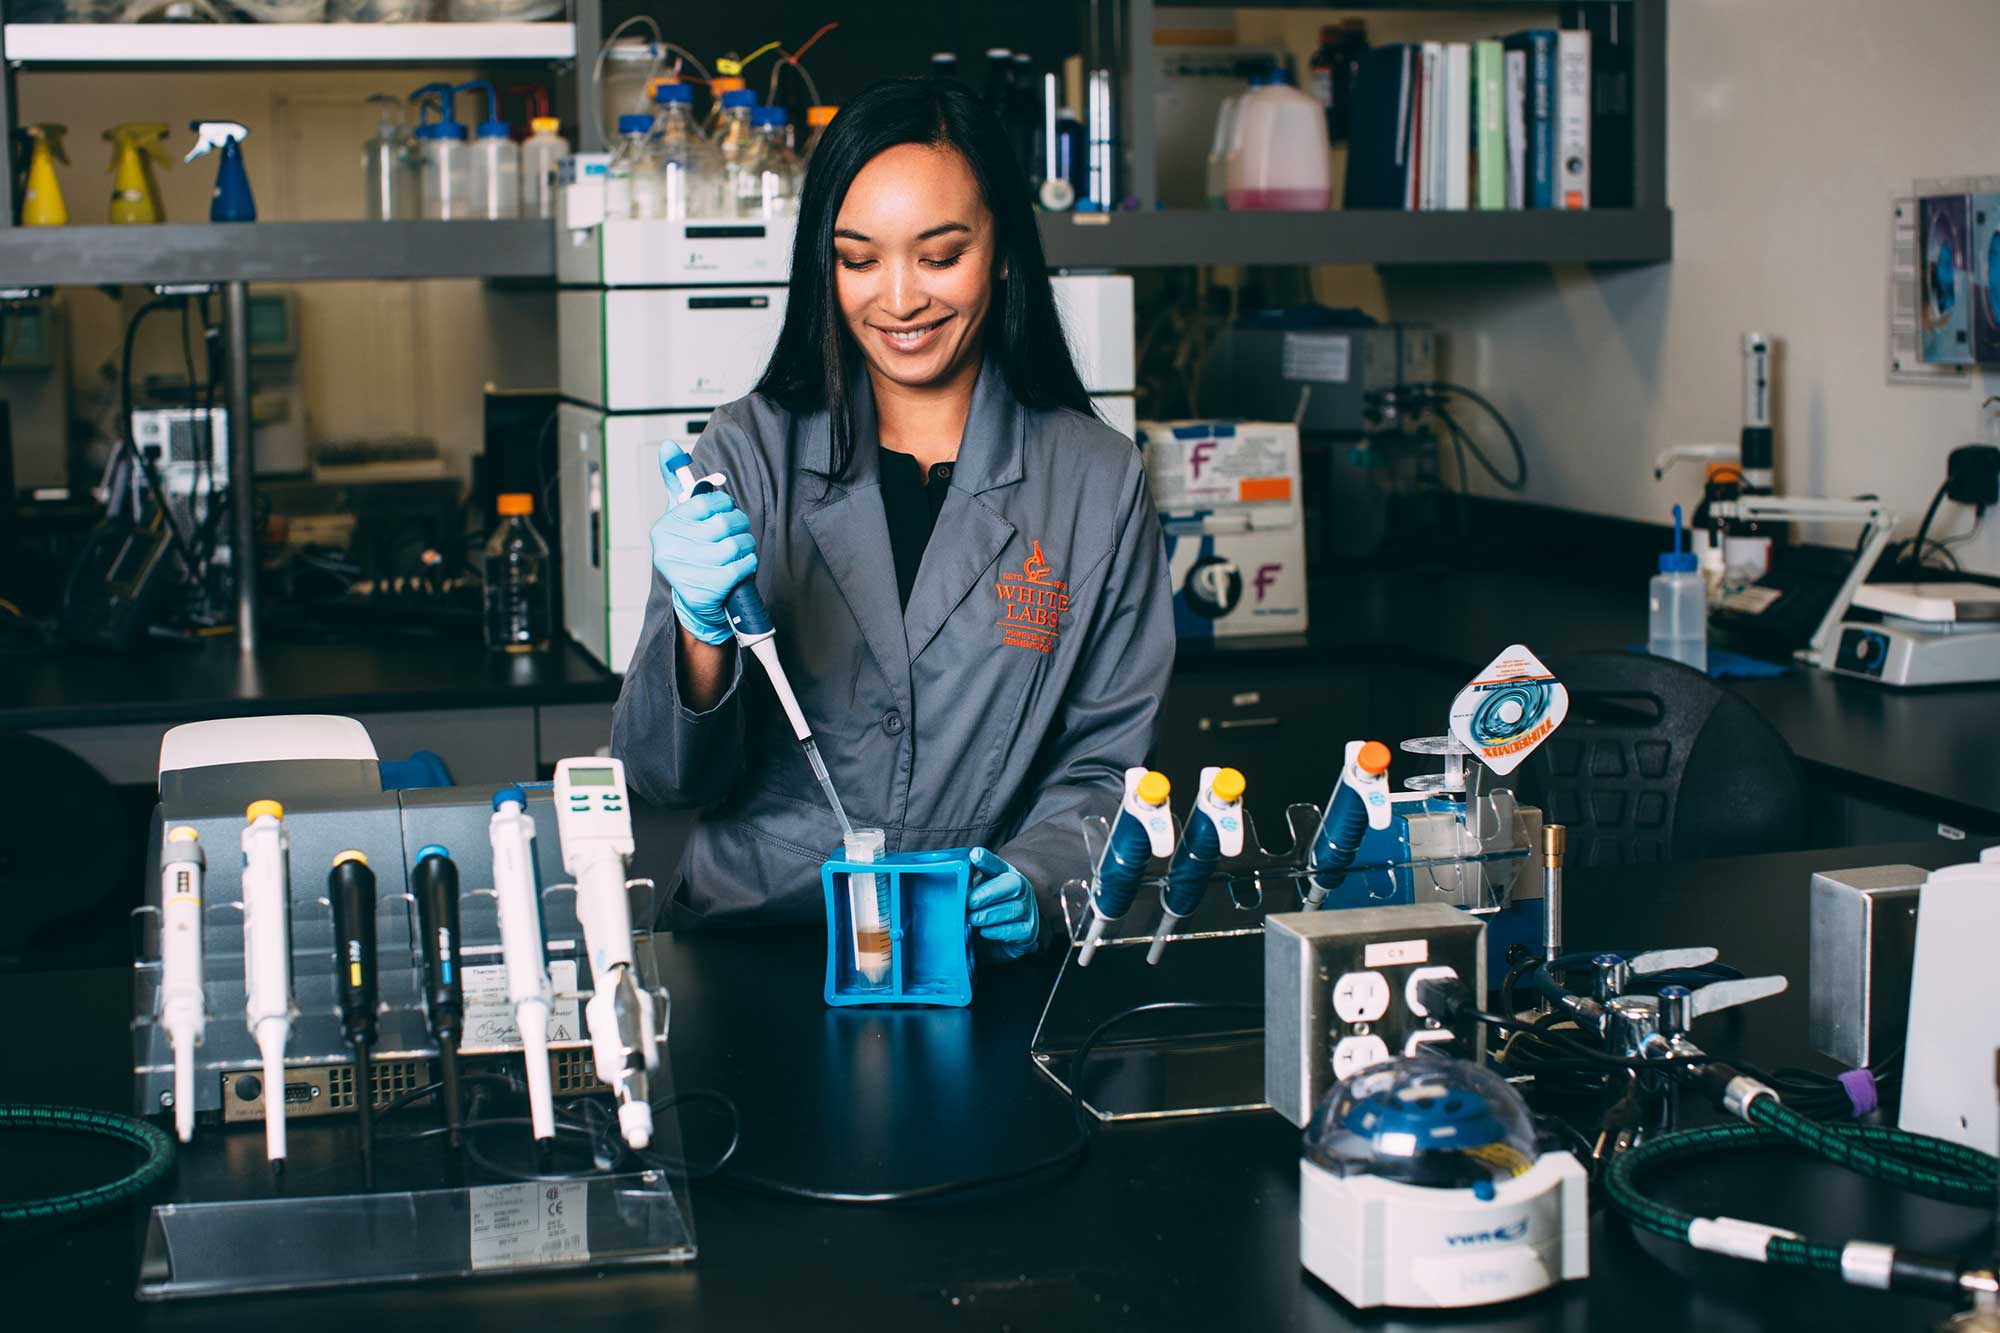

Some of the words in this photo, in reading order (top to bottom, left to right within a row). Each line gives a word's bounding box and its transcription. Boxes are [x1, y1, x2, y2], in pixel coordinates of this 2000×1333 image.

[995, 583, 1070, 612] WHITE
[1005, 603, 1060, 629] LABS
[1481, 716, 1554, 758] TURBOMIX
